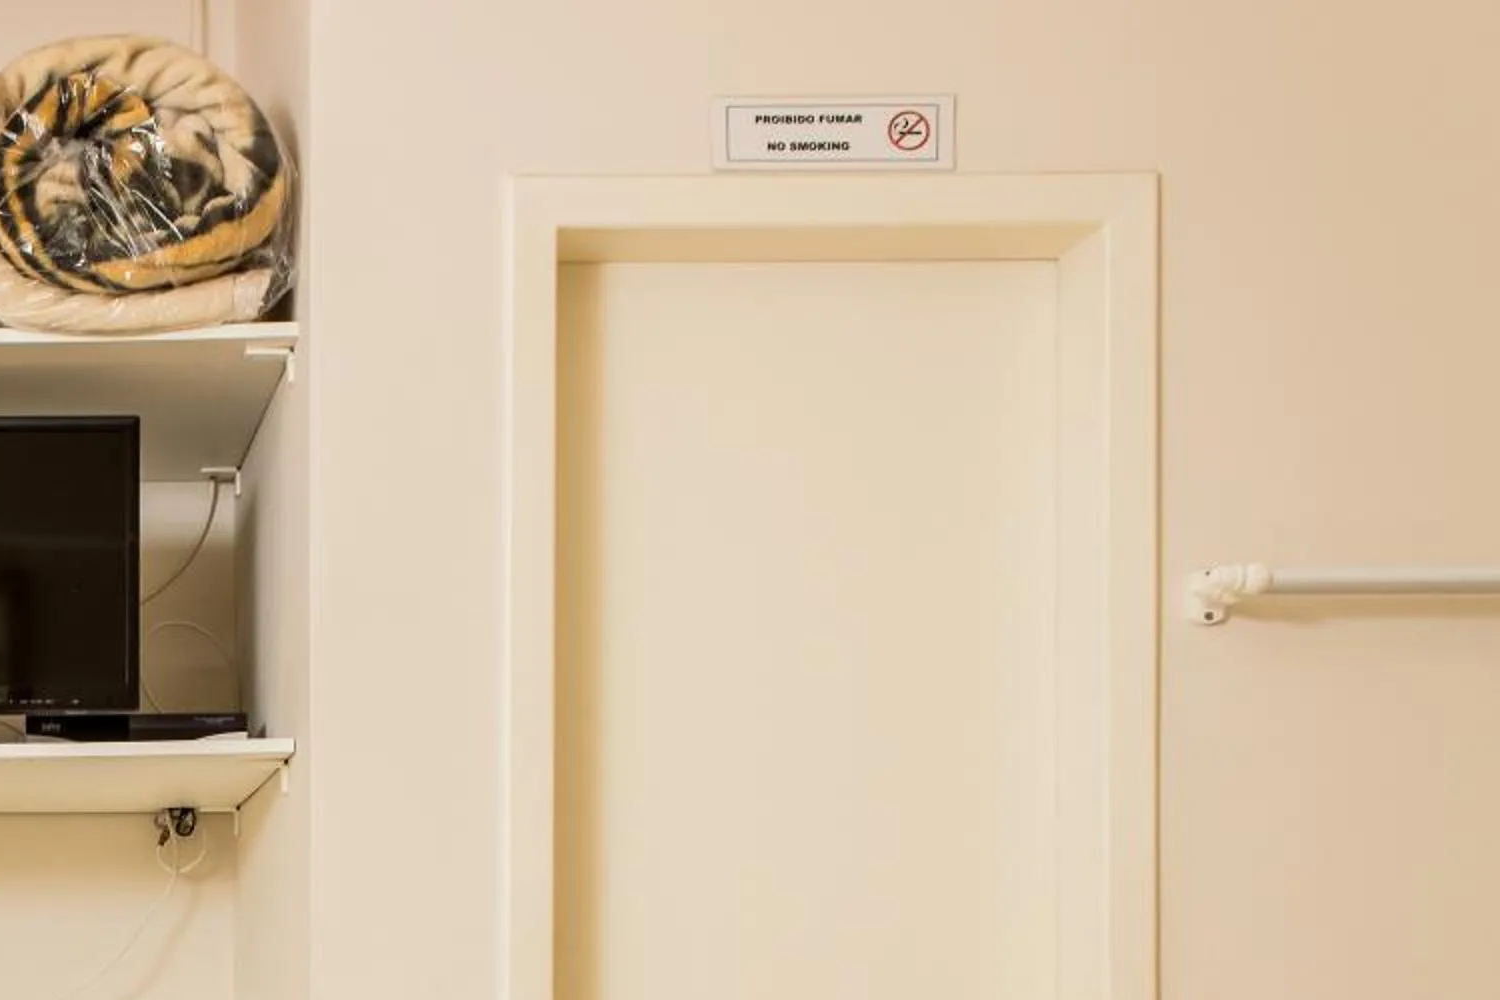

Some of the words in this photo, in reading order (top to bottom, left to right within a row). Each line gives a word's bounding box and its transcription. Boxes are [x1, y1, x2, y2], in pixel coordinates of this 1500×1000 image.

[755, 115, 815, 124] PROIBIDO
[819, 114, 862, 124] FUMAR
[767, 141, 786, 151] NO
[789, 141, 850, 151] SMOKING
